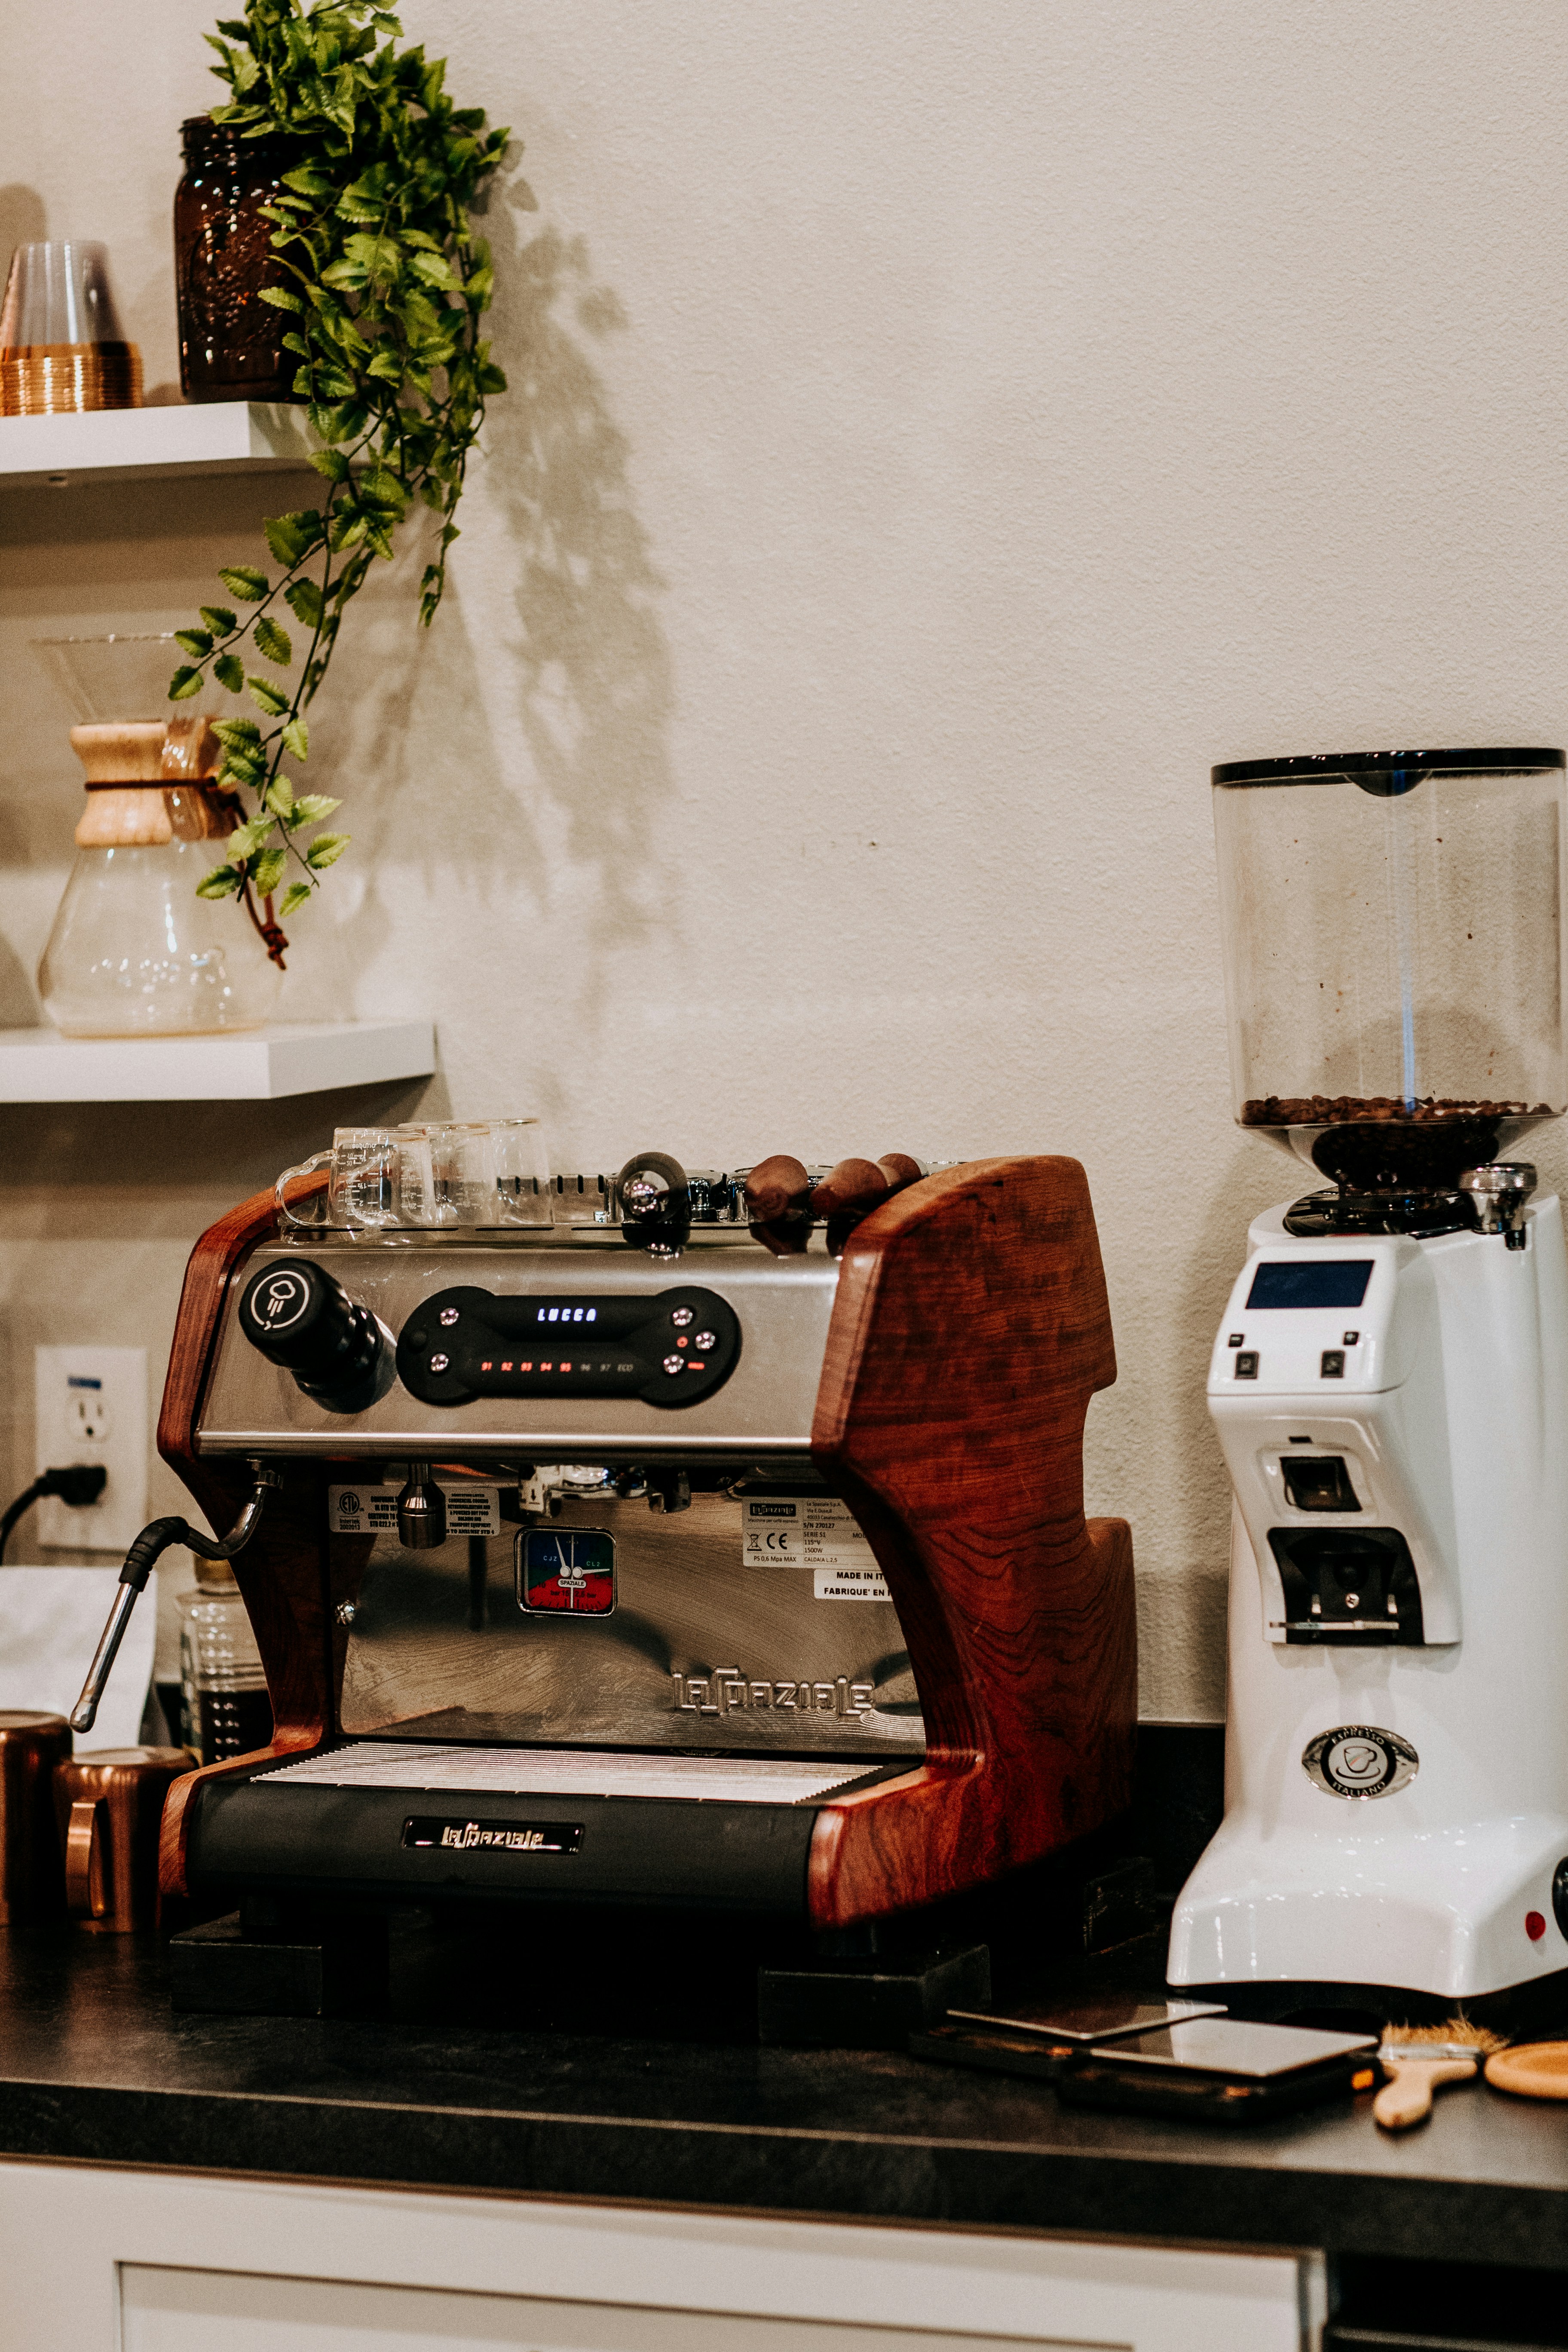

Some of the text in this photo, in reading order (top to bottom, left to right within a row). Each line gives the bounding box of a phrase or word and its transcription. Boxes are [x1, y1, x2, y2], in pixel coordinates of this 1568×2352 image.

[537, 1308, 597, 1322] LUCCA
[836, 1571, 861, 1580] MADE
[1331, 1728, 1385, 1746] ESPRESSO
[1332, 1780, 1386, 1797] ITALIANO
